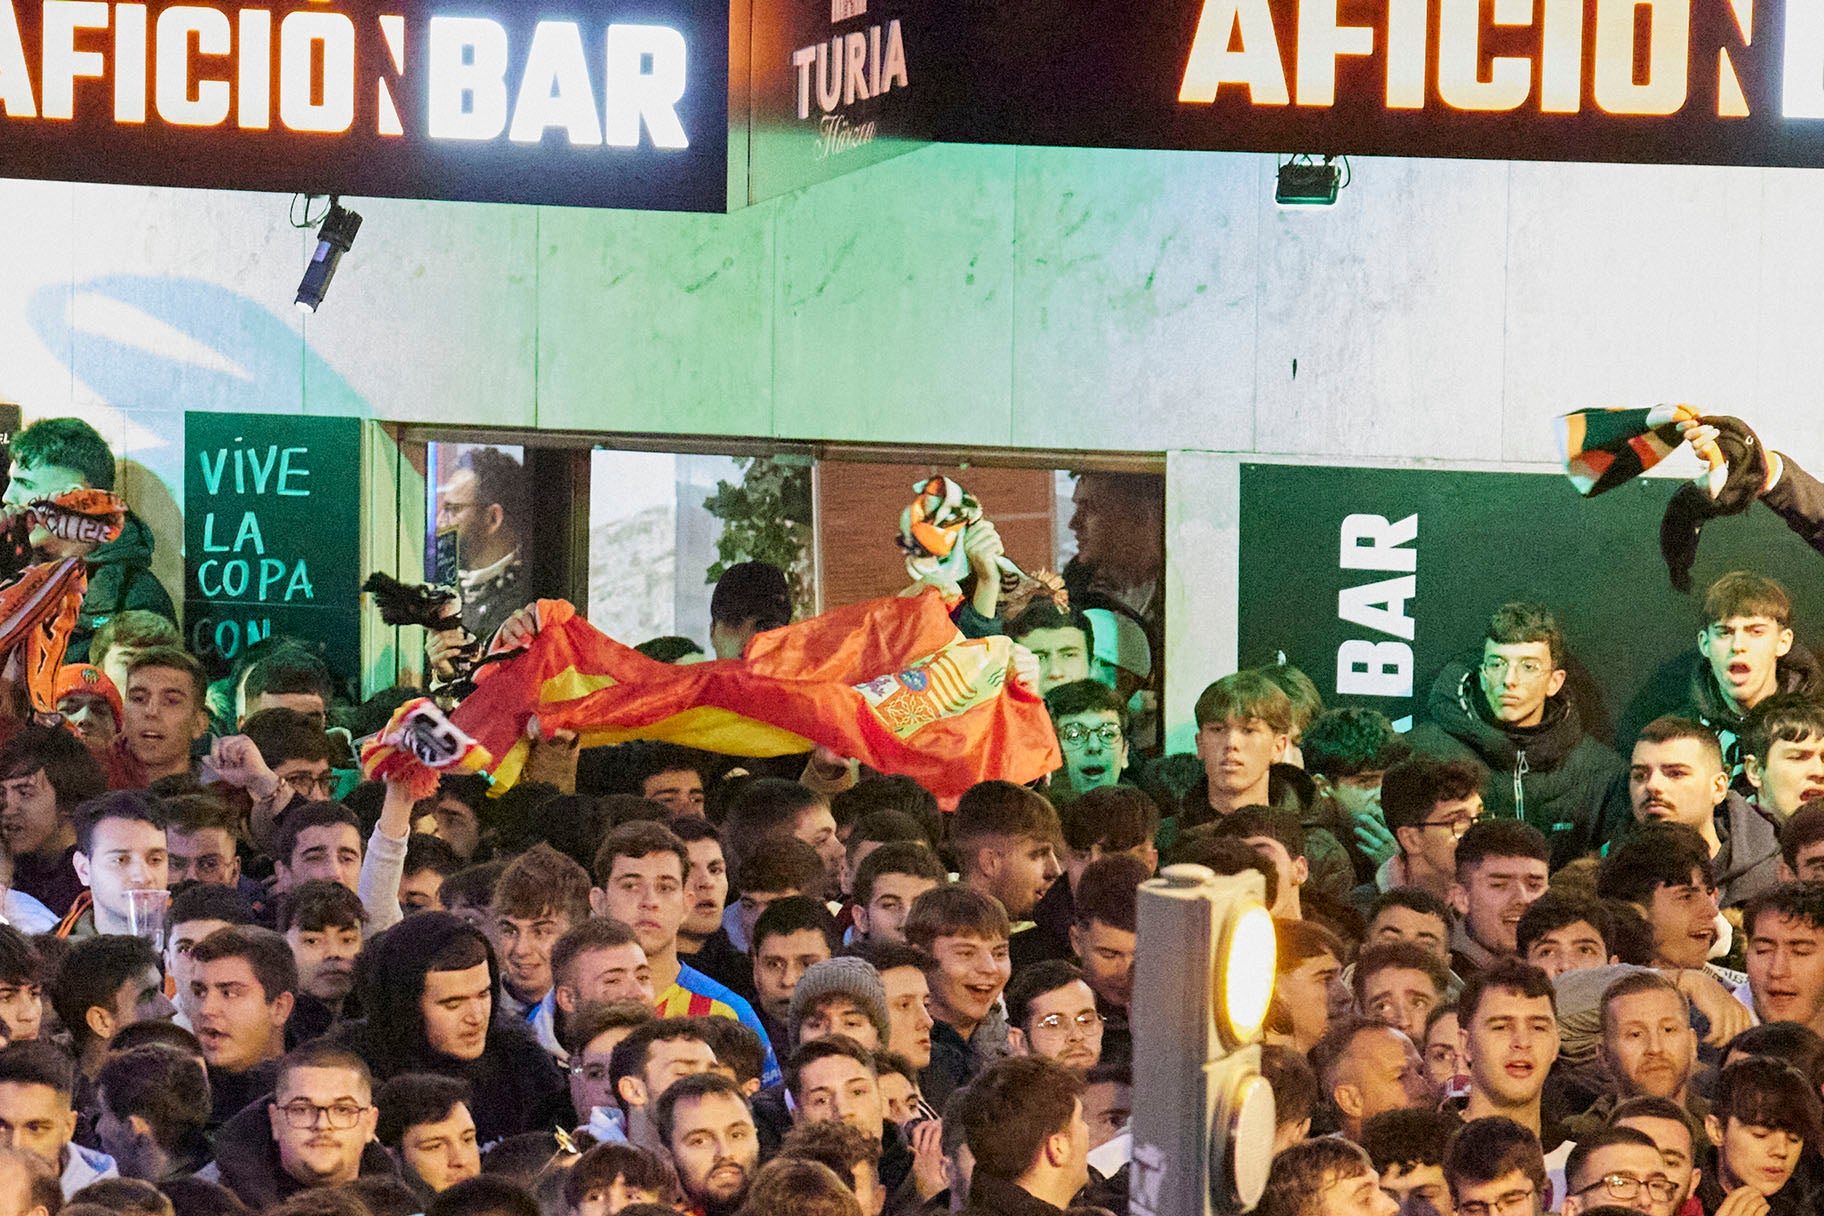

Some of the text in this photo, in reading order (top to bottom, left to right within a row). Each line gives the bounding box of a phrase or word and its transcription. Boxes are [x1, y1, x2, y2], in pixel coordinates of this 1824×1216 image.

[428, 16, 690, 148] BAR
[792, 19, 908, 119] TURIA
[197, 558, 314, 600] COPA
[203, 511, 265, 555] LA
[1336, 513, 1418, 697] BAR
